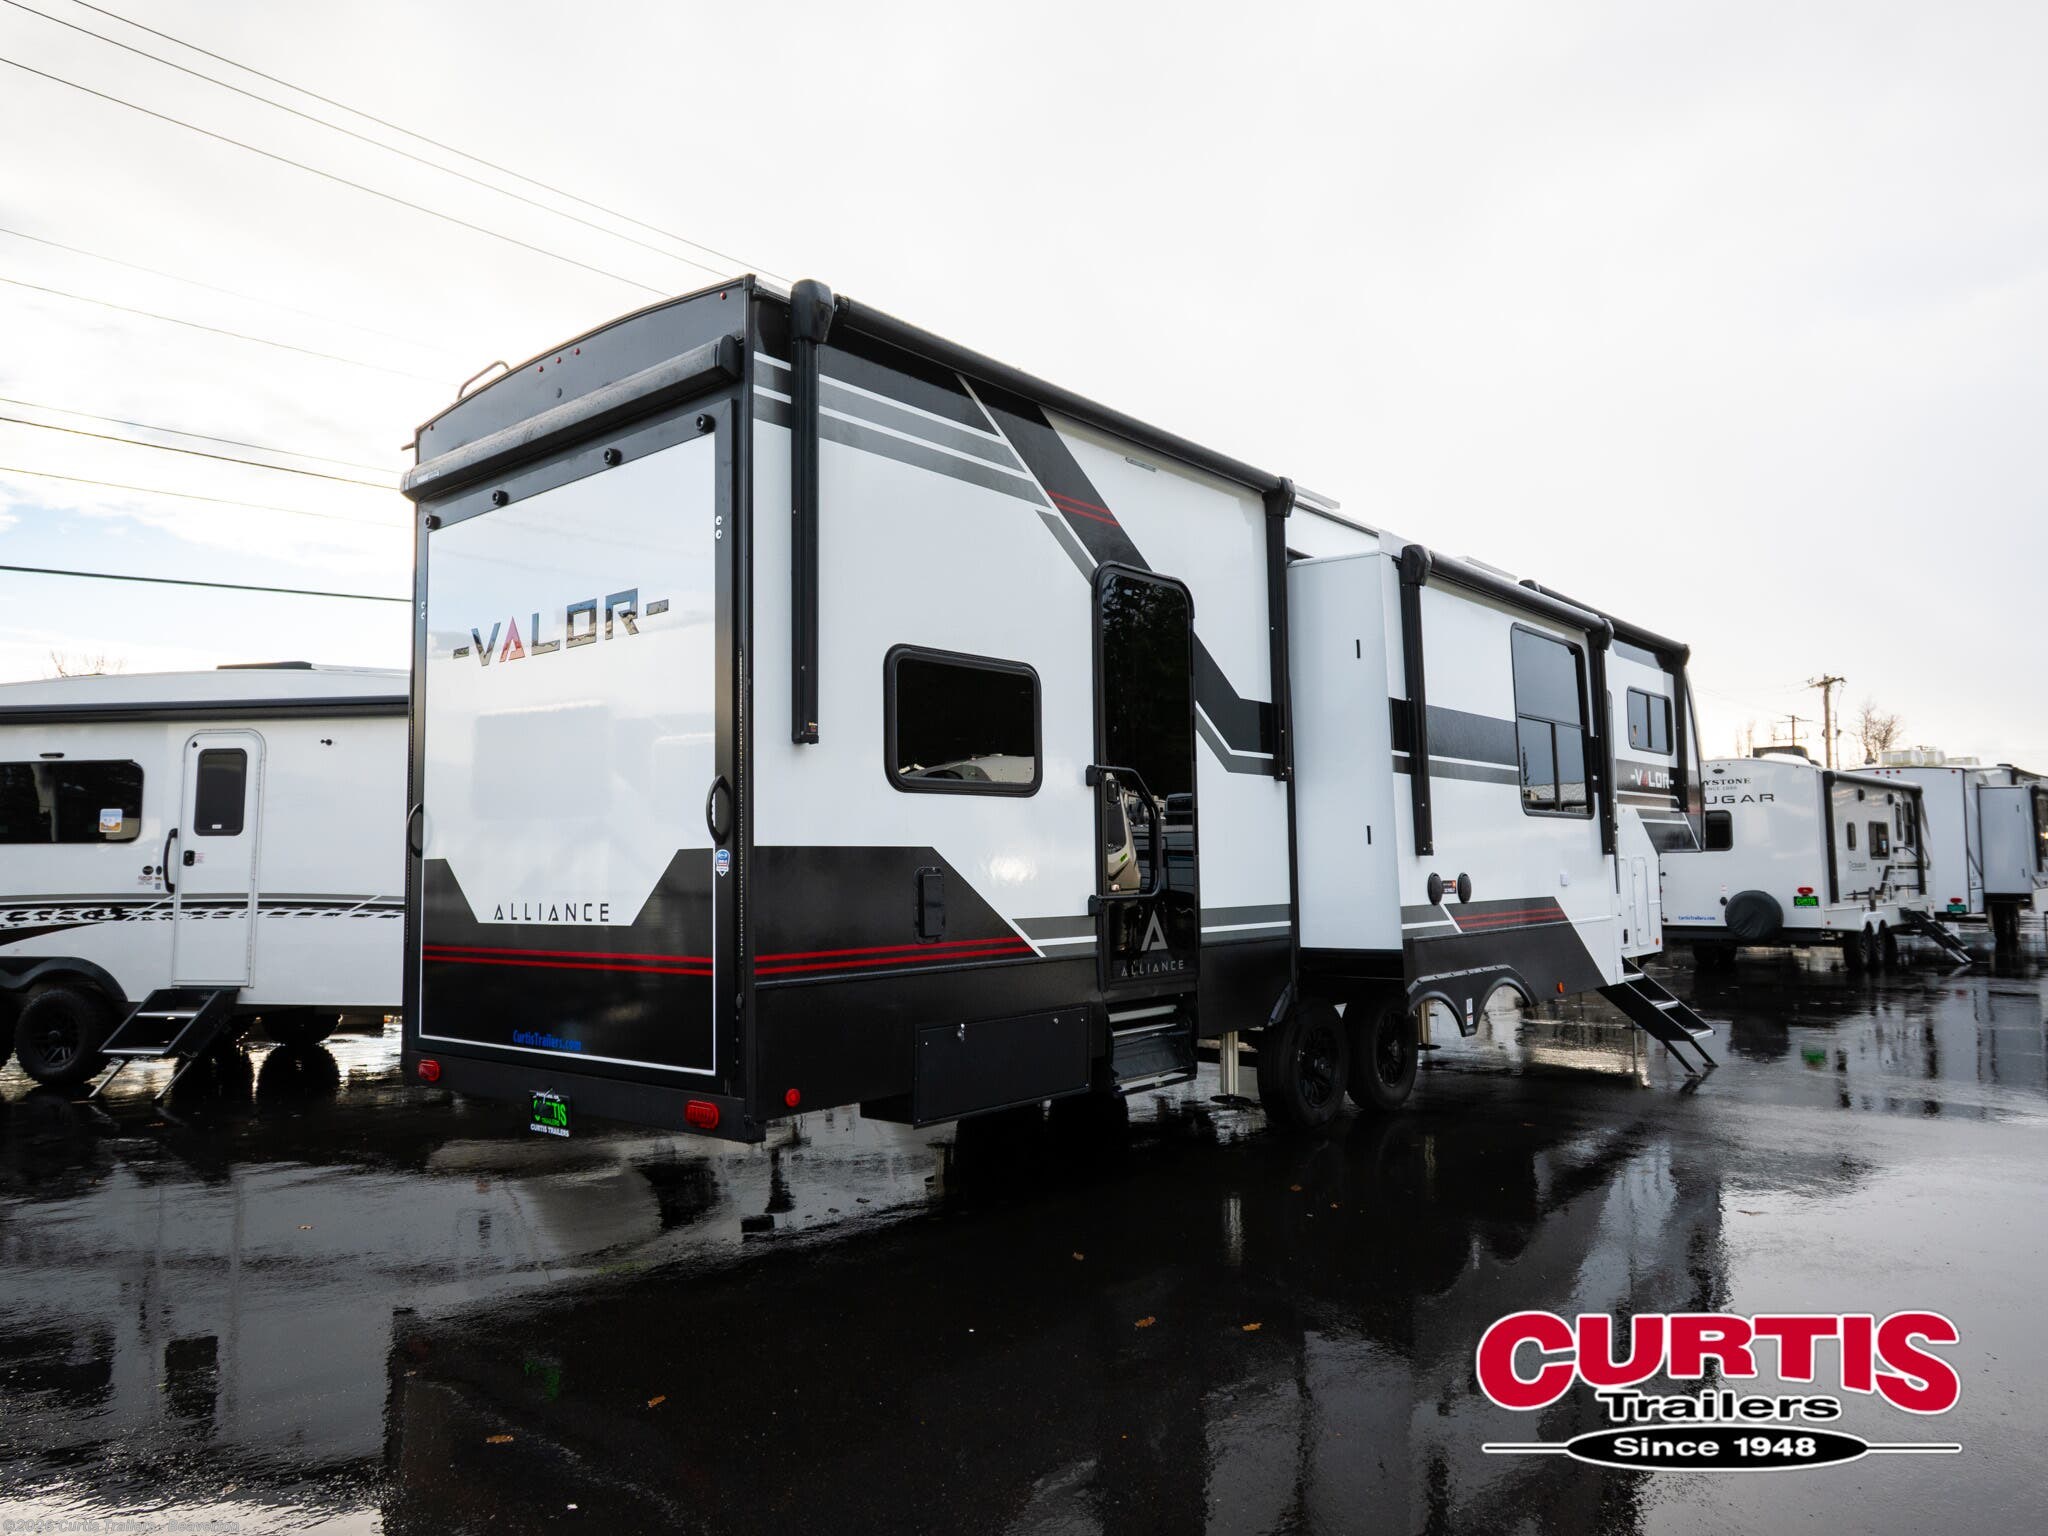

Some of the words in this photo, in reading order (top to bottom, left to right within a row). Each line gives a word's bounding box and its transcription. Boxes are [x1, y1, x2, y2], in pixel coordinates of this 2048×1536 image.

[494, 902, 609, 922] ALLIANCE
[1121, 959, 1184, 977] ALLIANCE
[513, 1029, 582, 1051] CurtisTrailers.com
